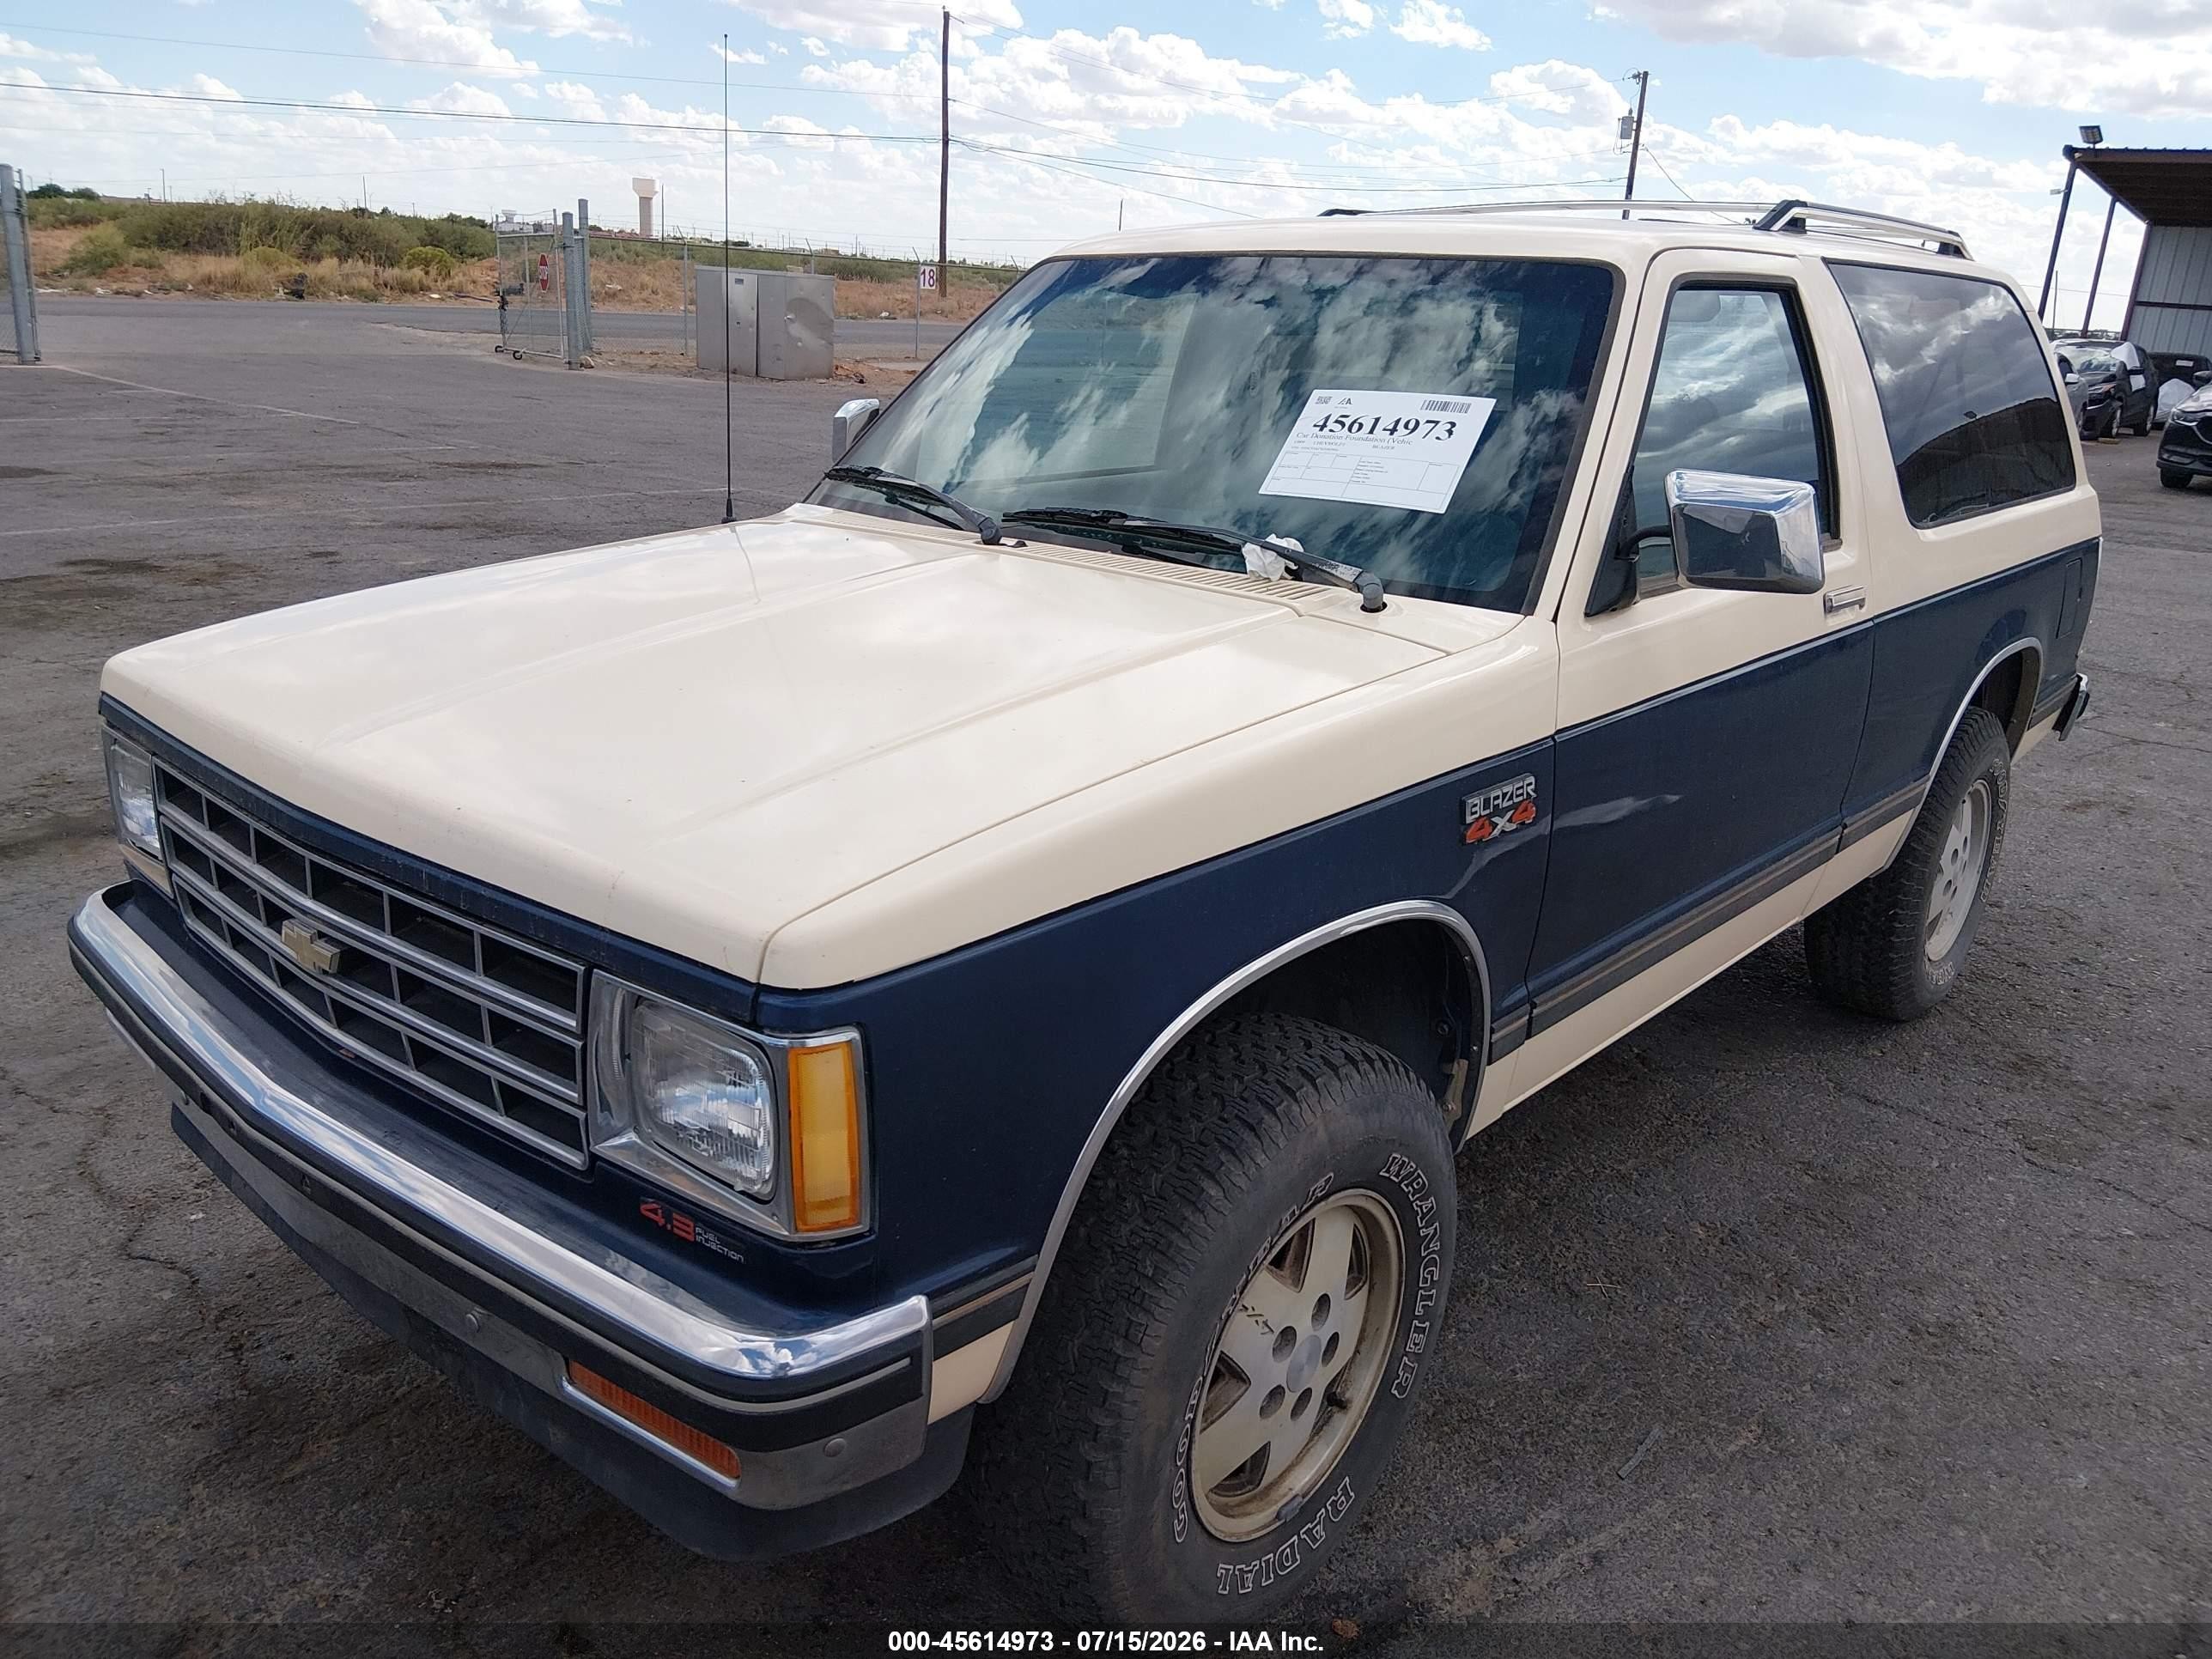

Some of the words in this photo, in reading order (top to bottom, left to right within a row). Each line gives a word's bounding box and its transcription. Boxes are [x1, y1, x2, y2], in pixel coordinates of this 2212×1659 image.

[921, 268, 935, 288] 18
[1310, 432, 1344, 441] Donation
[1345, 433, 1386, 444] Foundation
[1312, 413, 1457, 441] 45614973
[1465, 775, 1537, 824] BLAZER
[639, 1202, 696, 1243] 4.3
[695, 1226, 721, 1244] FUEL
[696, 1235, 745, 1263] INJECTION
[1380, 1153, 1441, 1400] WRANGLER
[1217, 1476, 1357, 1595] RADIAL
